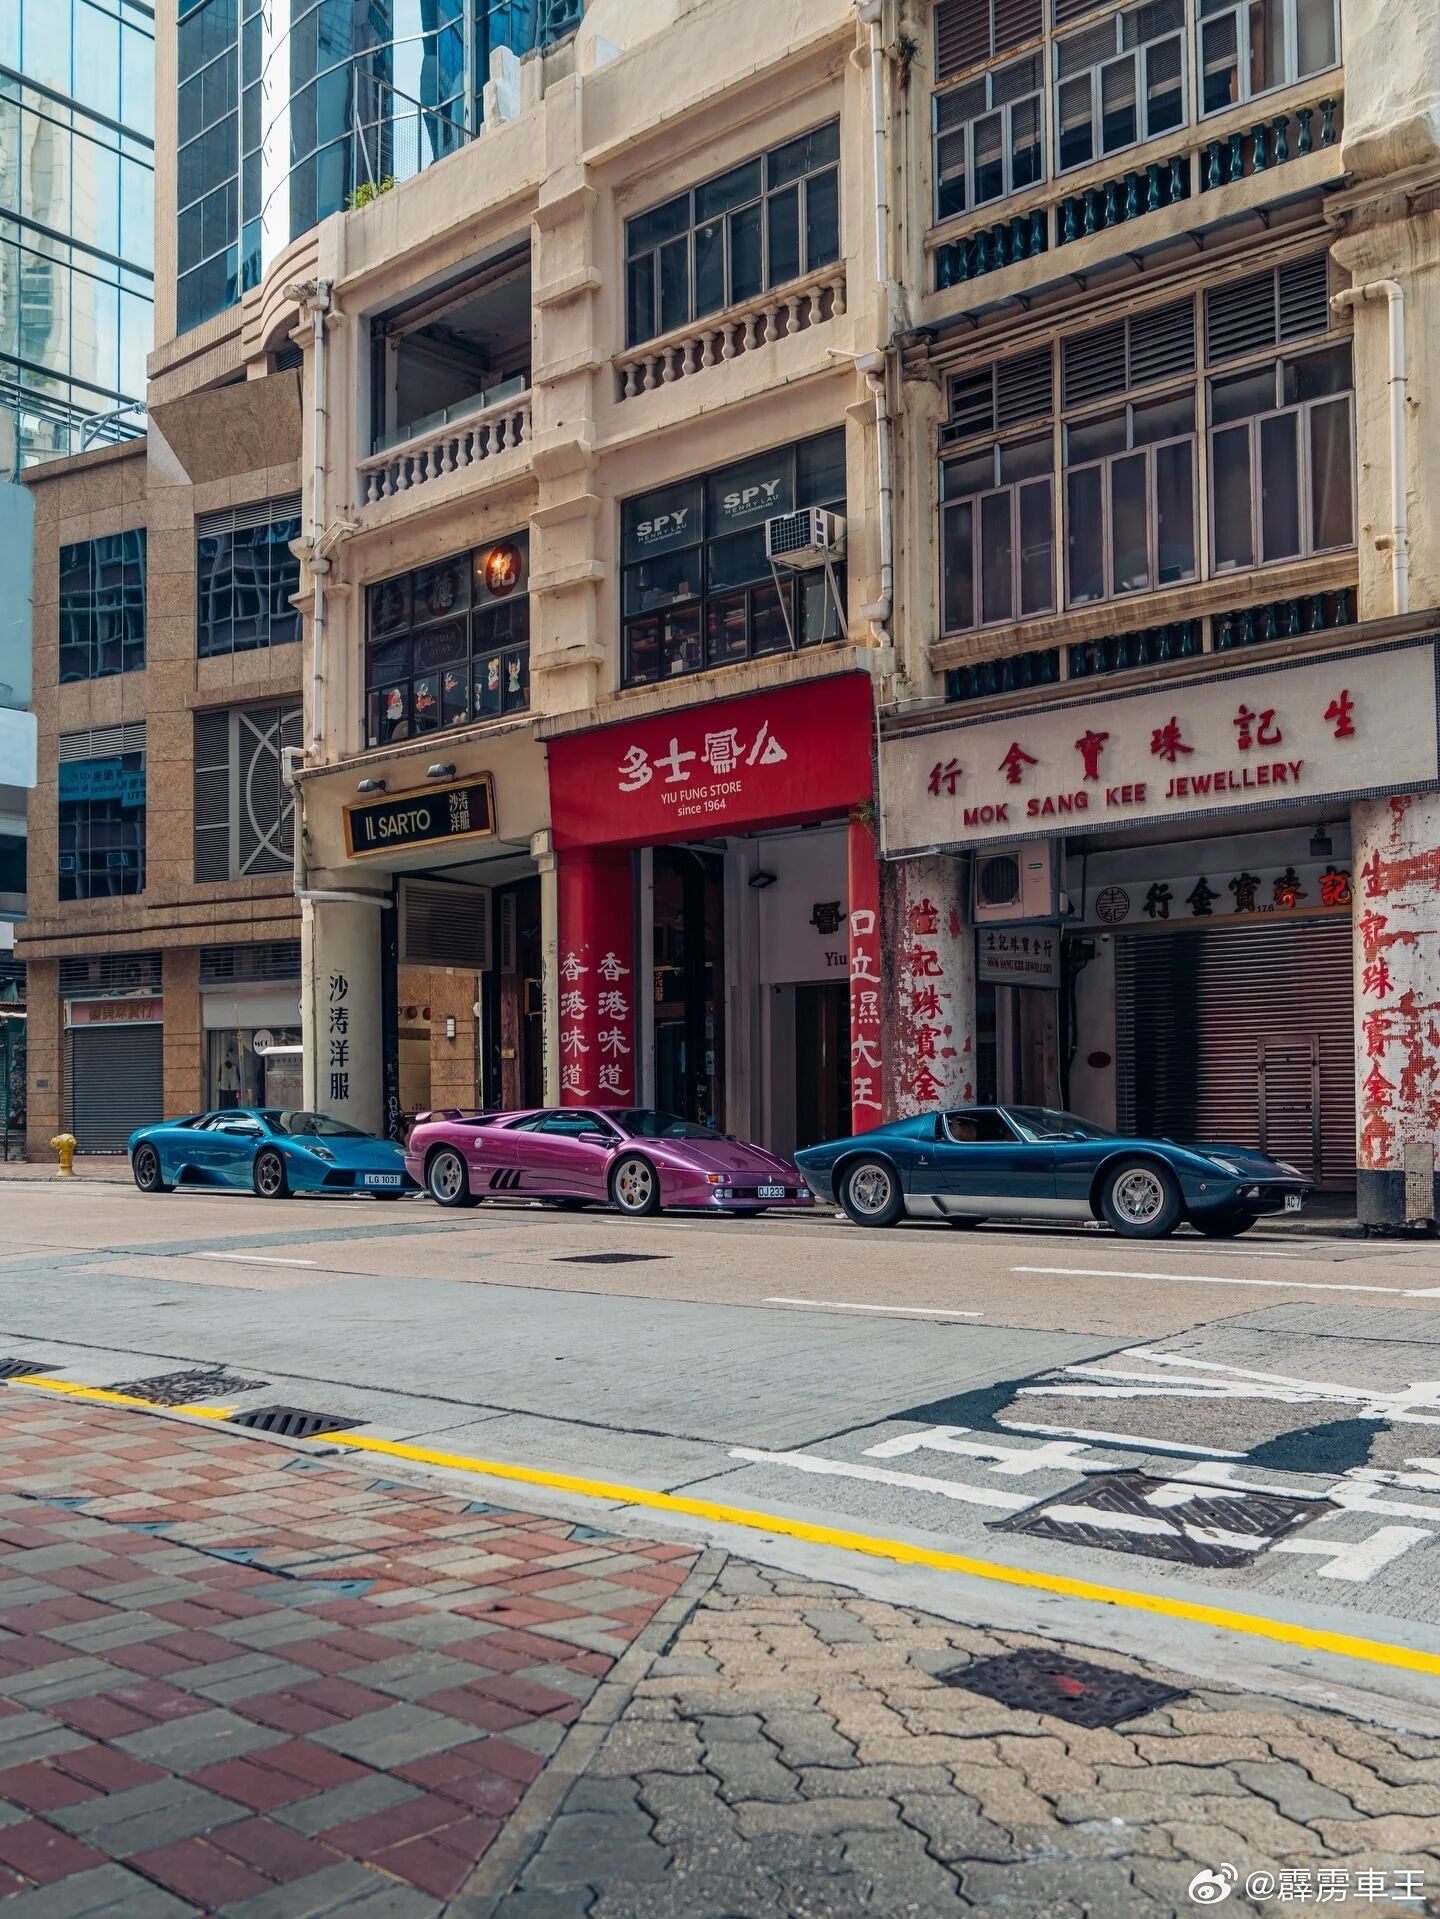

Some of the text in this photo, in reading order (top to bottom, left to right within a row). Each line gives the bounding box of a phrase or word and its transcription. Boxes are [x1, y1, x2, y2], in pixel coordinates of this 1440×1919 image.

[723, 478, 781, 509] SPY
[725, 499, 758, 514] HENRY
[760, 494, 779, 504] LAU
[636, 508, 689, 537] SPY
[638, 528, 670, 542] HENRY
[670, 523, 687, 532] LAU
[661, 780, 743, 805] YIU FUNG STORE
[964, 759, 1304, 827] MOK SANG KEE JEWELLERY
[677, 798, 727, 816] since 1964
[365, 808, 431, 841] IL SARTO
[1256, 903, 1275, 913] 176
[823, 951, 848, 966] Yiu
[559, 951, 591, 1097] 香港味道
[597, 951, 631, 1096] 香港味道
[329, 974, 350, 1100] 沙涛洋服
[368, 1175, 398, 1184] LG 1031
[759, 1187, 784, 1197] DJ 233
